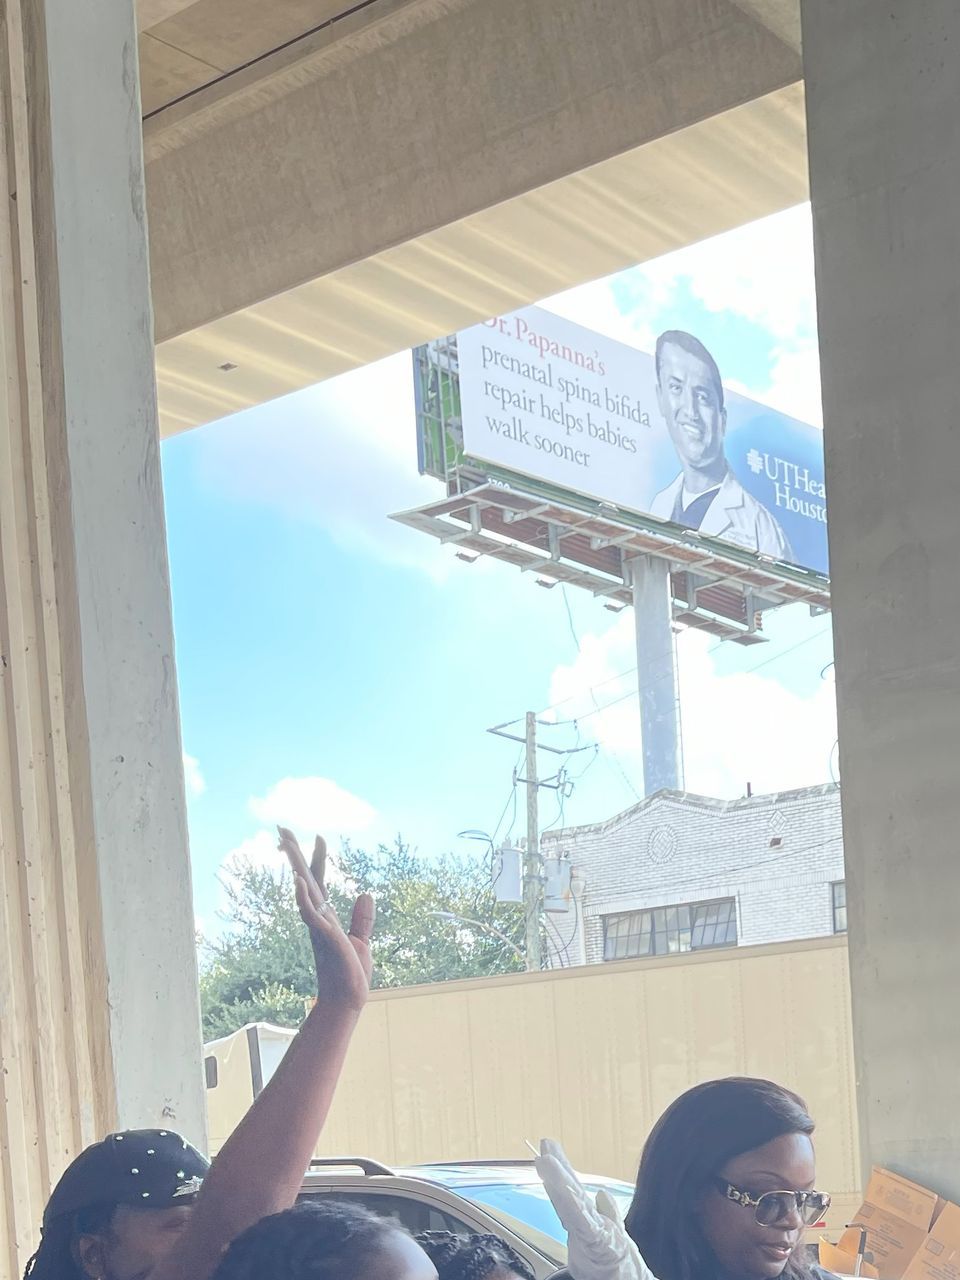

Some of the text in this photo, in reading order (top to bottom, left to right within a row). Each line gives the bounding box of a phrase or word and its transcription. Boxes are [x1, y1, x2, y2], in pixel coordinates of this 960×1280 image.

[515, 316, 606, 376] Papanna's
[482, 345, 651, 428] prenatal spina bifida
[484, 381, 637, 453] repair helps babies
[485, 416, 590, 467] walk sooner
[762, 453, 826, 498] UTHea
[774, 482, 828, 523] Housto
